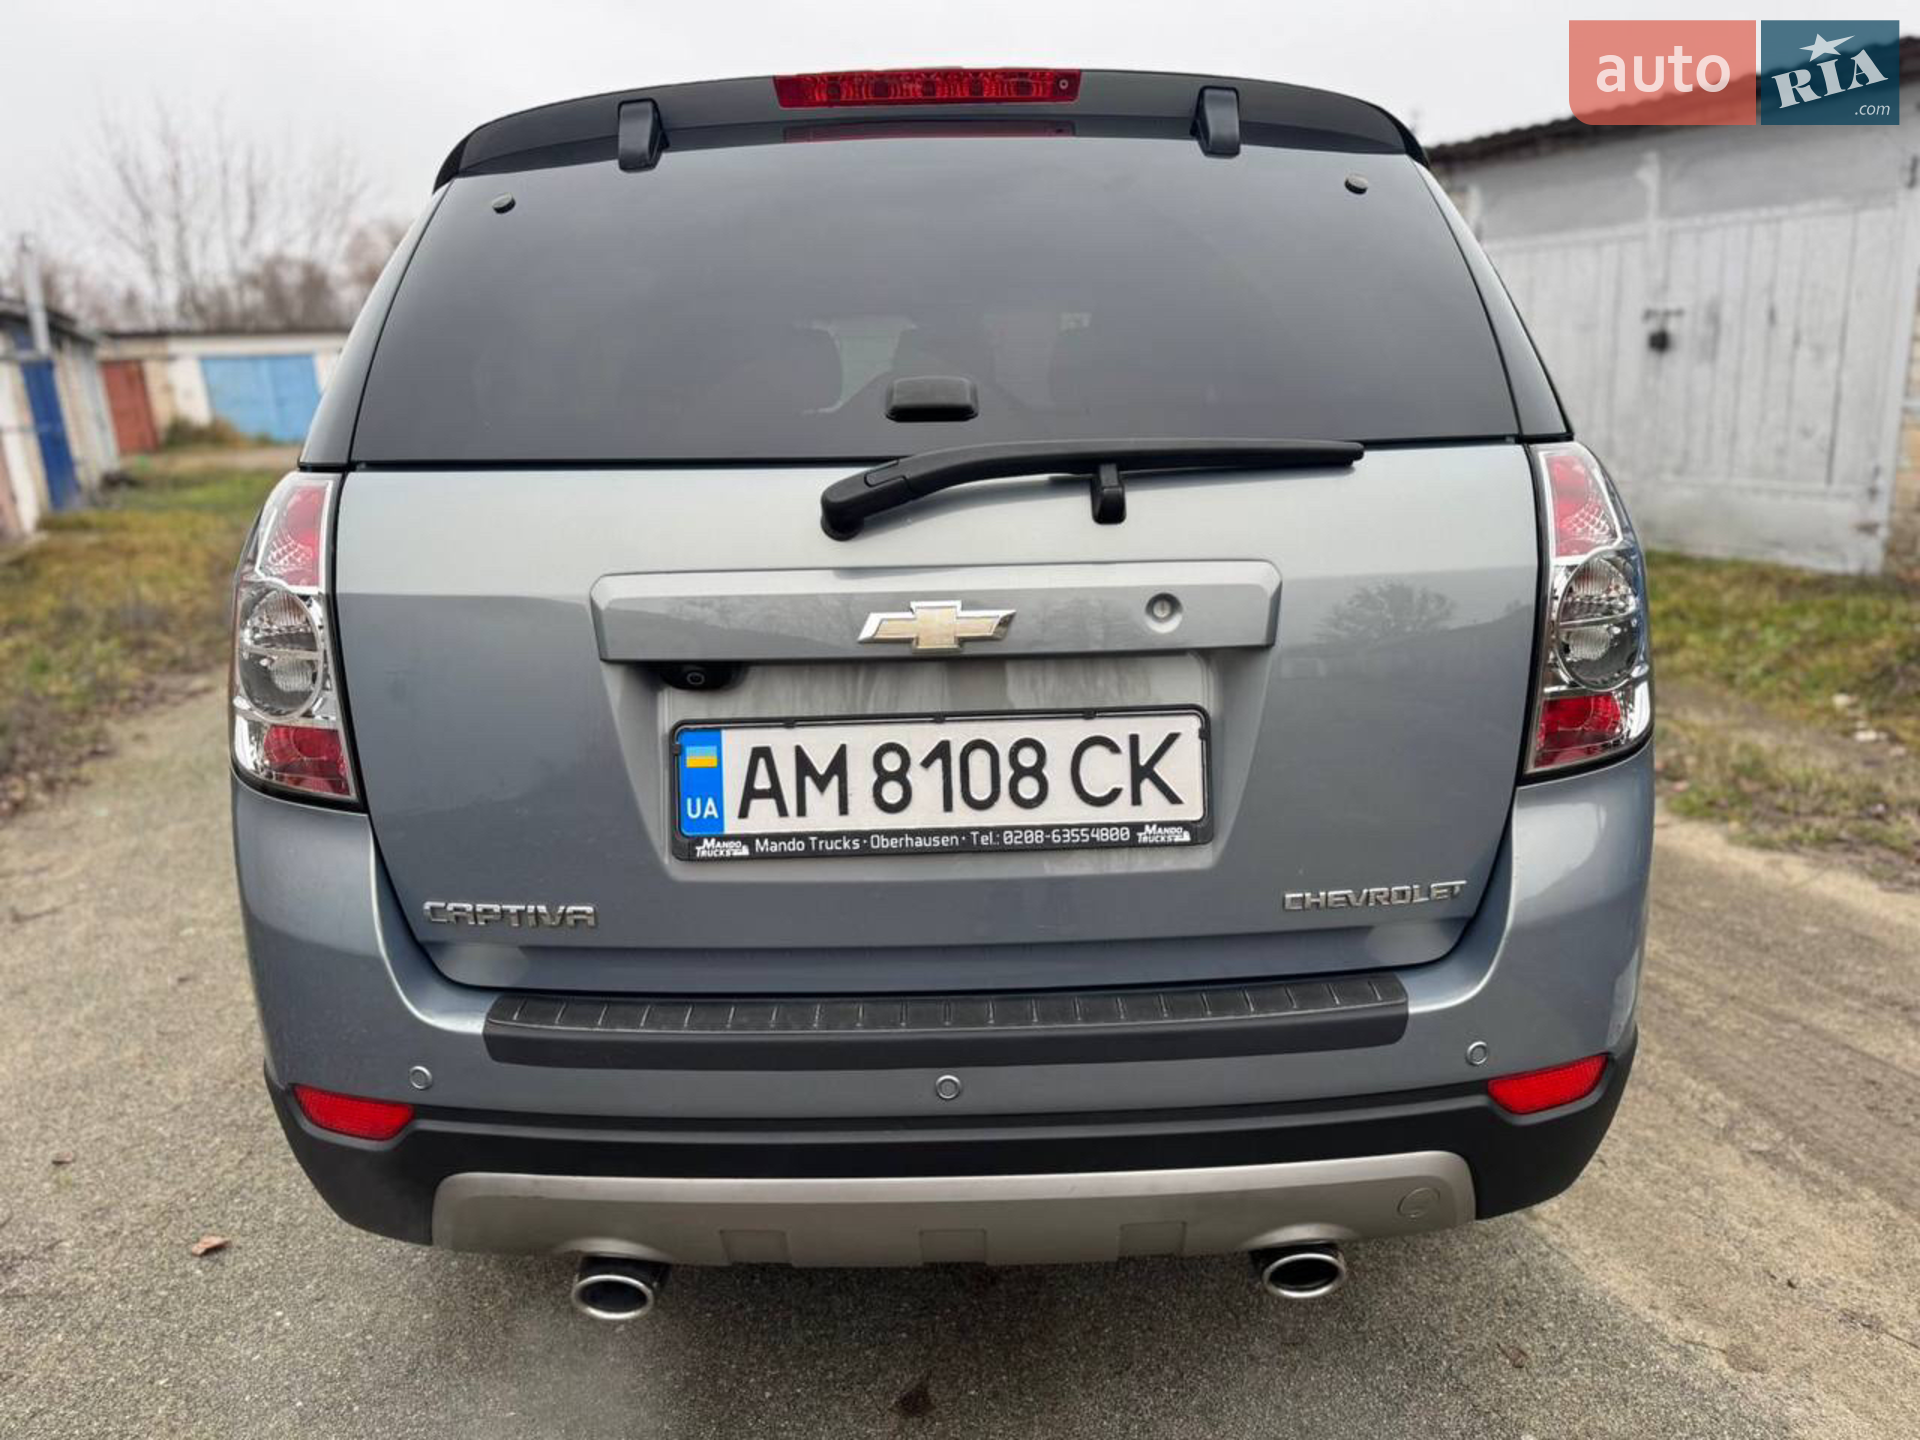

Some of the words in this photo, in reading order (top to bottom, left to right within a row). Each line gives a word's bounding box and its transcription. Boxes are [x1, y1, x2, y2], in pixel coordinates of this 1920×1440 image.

[737, 743, 848, 819] AM
[872, 738, 1049, 813] 8108
[1070, 732, 1184, 807] CK
[687, 797, 719, 819] UA
[755, 838, 805, 852] Mando
[809, 835, 860, 850] Trucks
[870, 832, 959, 848] Oberhausen
[1002, 827, 1131, 845] 0208-63554800
[1284, 880, 1467, 910] CHEVROLET
[423, 901, 596, 927] CAPTIVA
